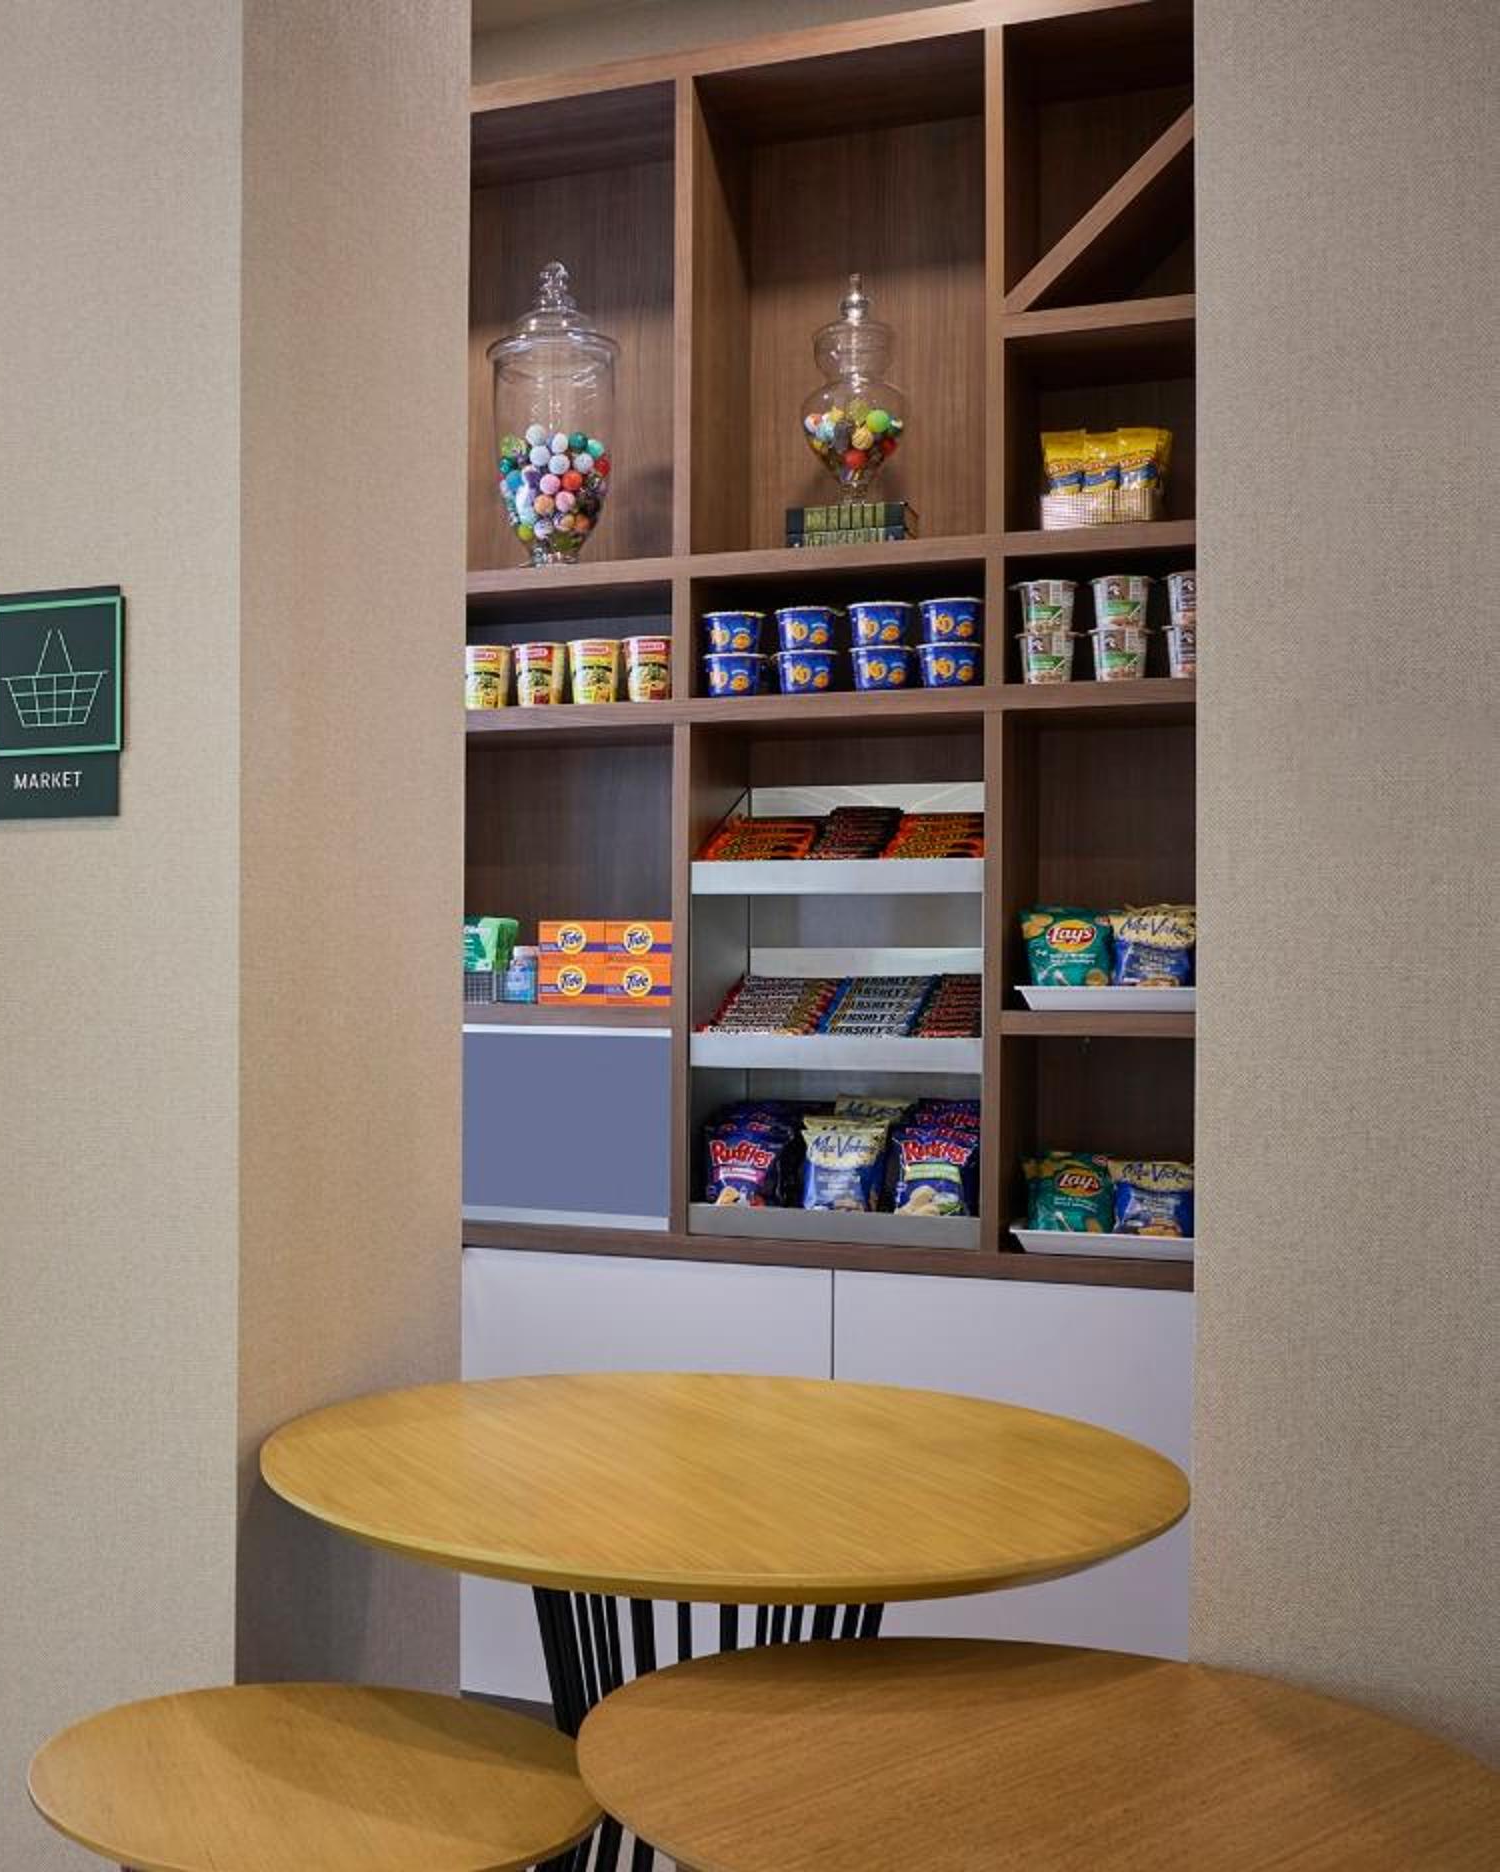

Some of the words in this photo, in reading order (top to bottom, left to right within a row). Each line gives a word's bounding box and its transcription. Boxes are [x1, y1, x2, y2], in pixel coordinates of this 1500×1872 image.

[13, 771, 83, 790] MARKET
[561, 929, 583, 948] Tide
[627, 929, 651, 949] Tide
[561, 971, 583, 989] Tide
[626, 972, 649, 990] Tide
